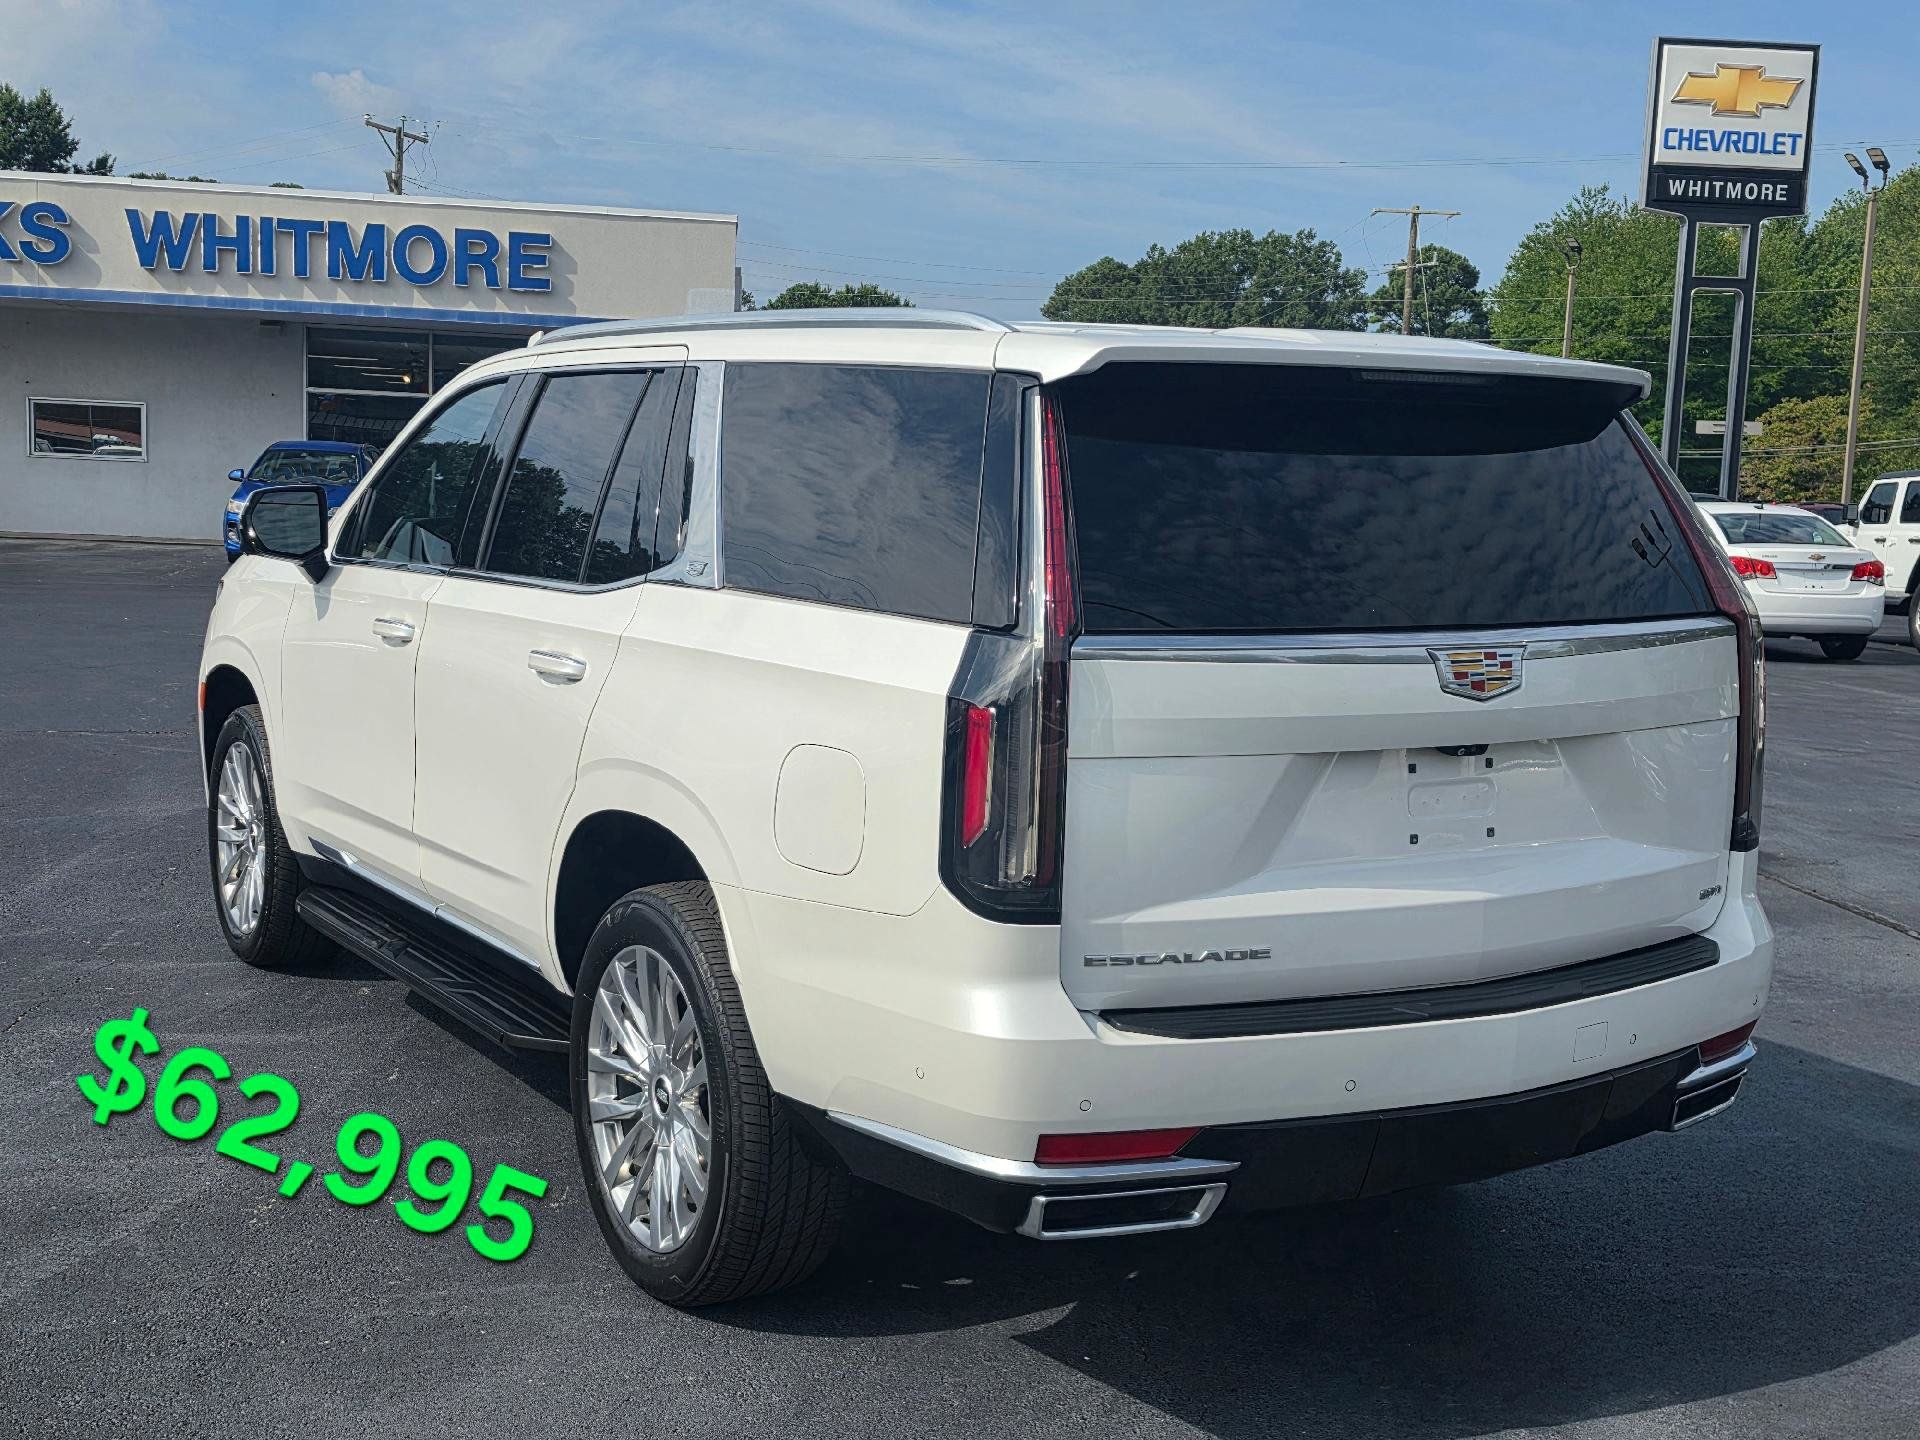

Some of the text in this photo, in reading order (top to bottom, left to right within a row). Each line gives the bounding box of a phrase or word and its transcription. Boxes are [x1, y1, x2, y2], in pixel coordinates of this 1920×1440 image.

[1663, 127, 1803, 156] CHEVROLET
[1668, 179, 1789, 201] WHITMORE
[124, 208, 552, 291] WHITMORE
[1083, 947, 1272, 967] ESCALADE
